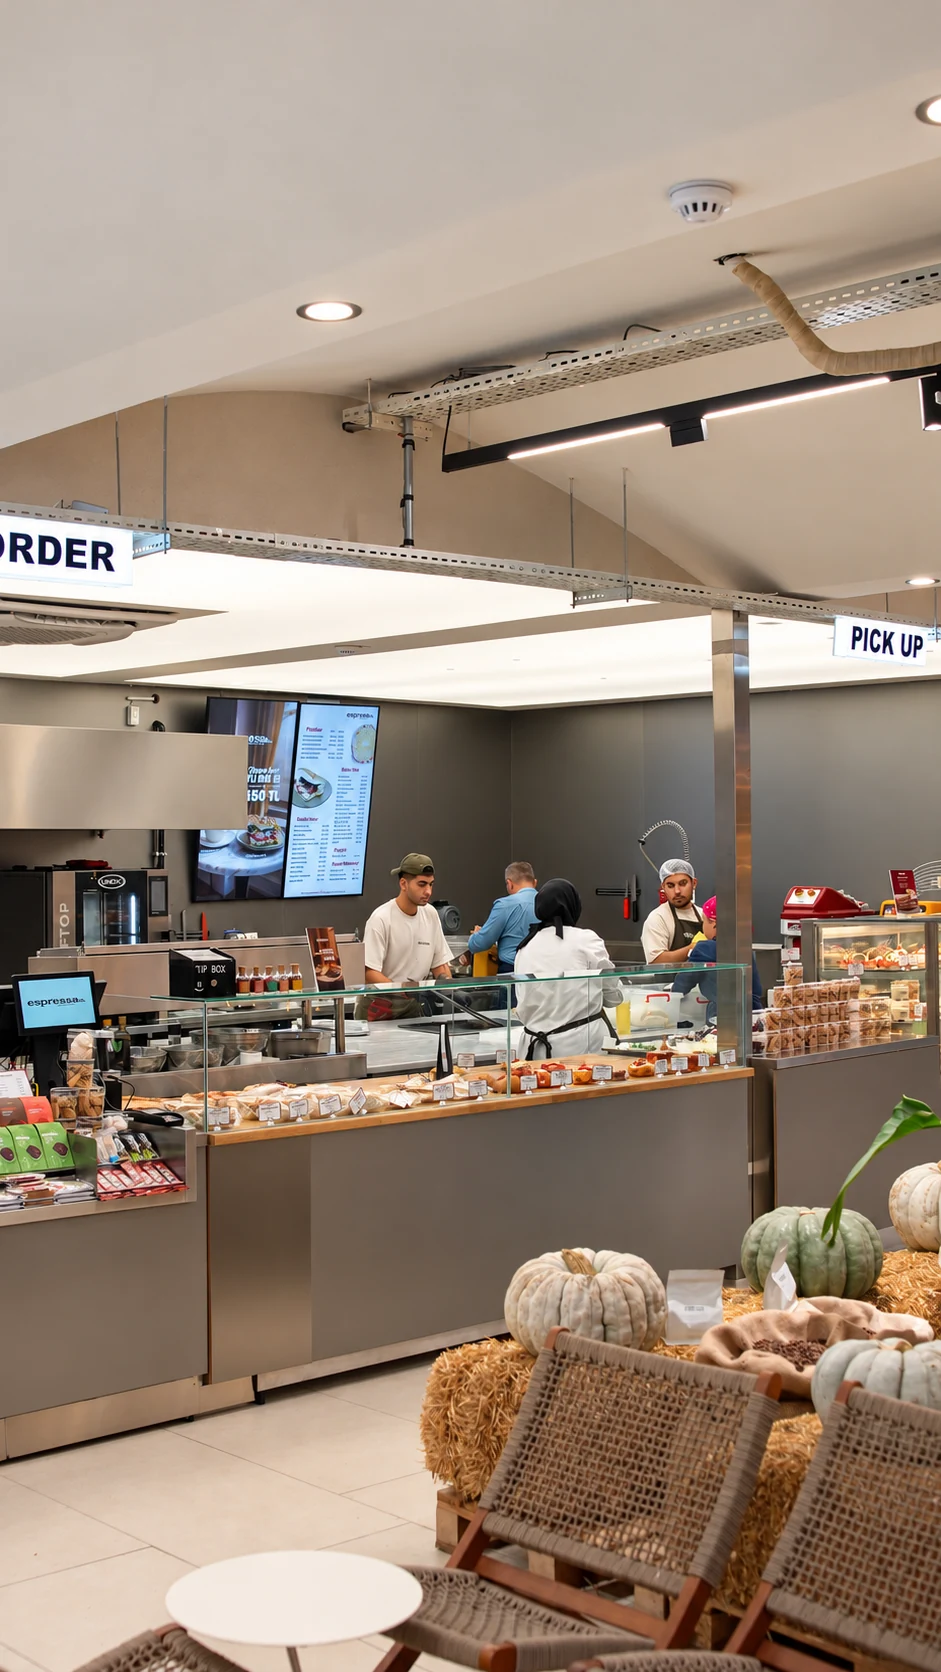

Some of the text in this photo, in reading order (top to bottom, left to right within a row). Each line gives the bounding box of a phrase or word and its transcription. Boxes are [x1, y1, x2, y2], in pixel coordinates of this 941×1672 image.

[0, 531, 115, 572] RDER
[851, 625, 924, 658] PICK UP
[195, 964, 226, 974] TIP BOX
